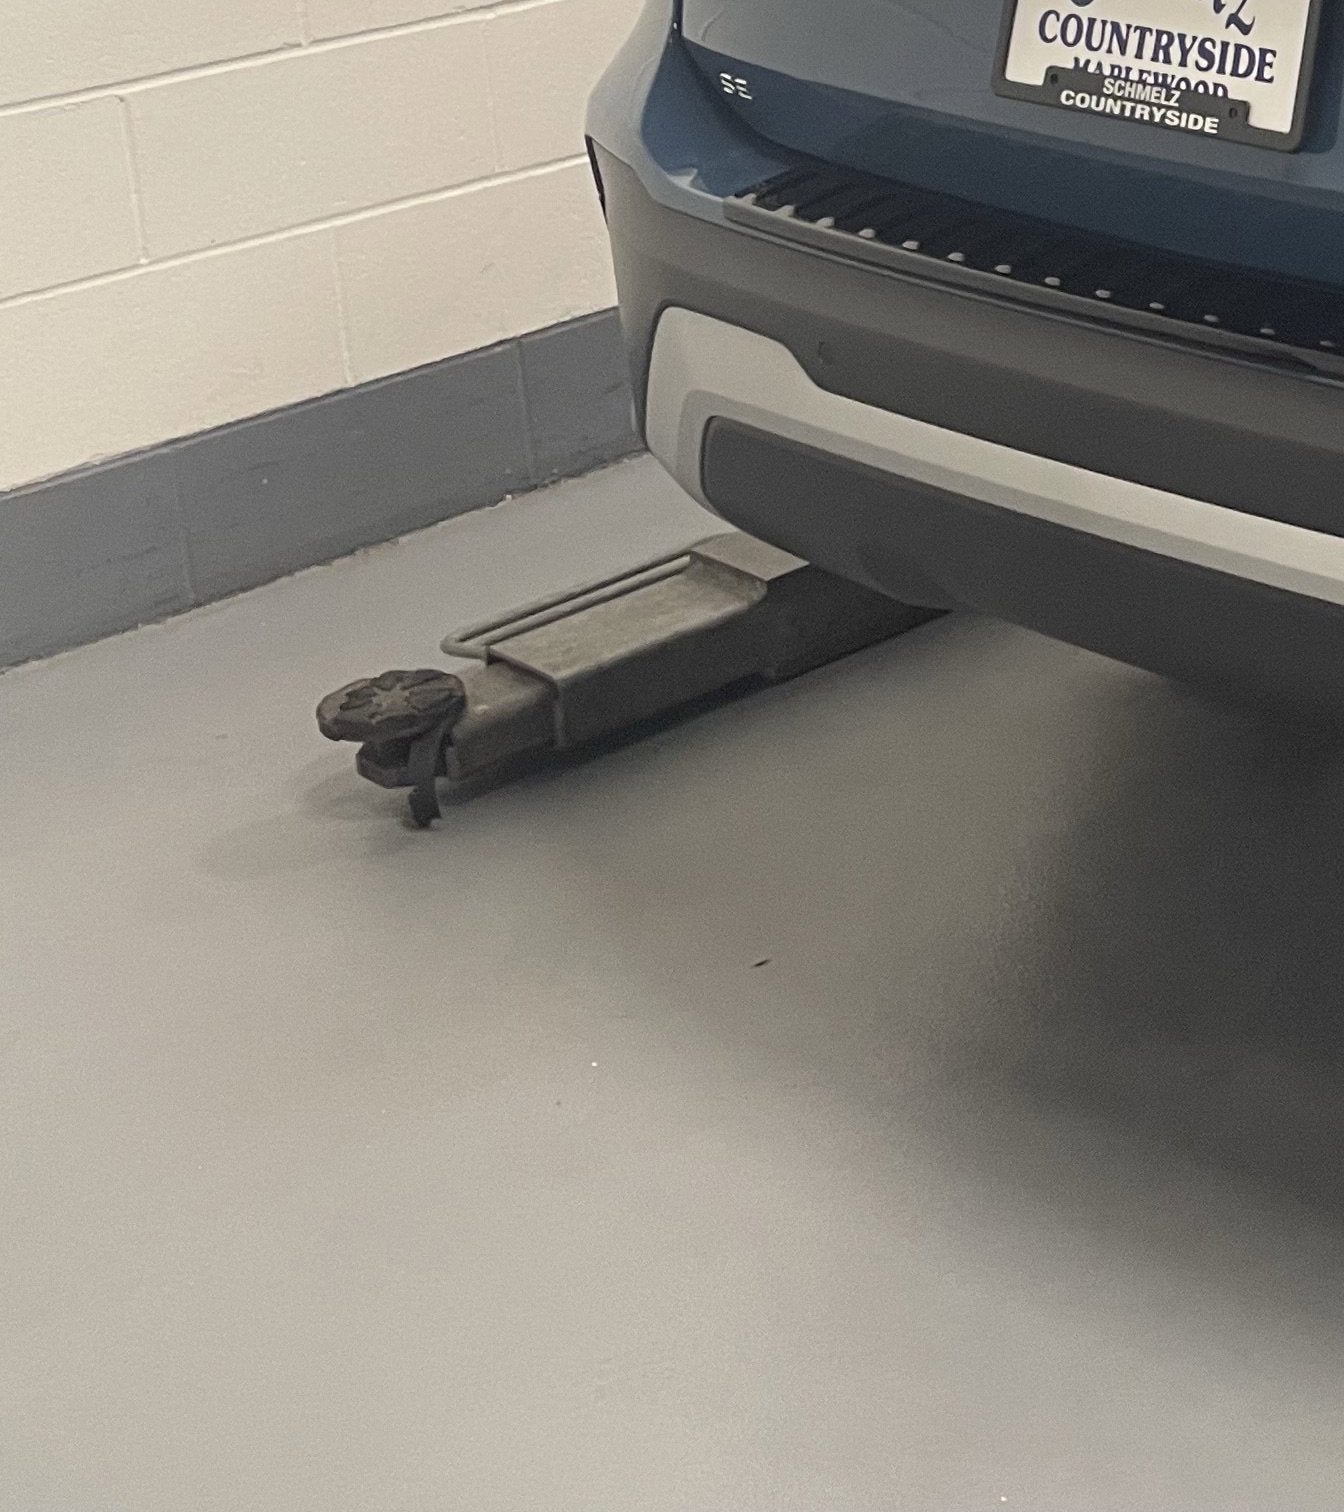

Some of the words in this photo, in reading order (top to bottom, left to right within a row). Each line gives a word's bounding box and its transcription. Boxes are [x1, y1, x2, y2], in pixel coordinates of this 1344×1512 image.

[1039, 9, 1277, 84] COUNTRYSIDE
[719, 72, 752, 100] SE
[1103, 78, 1181, 107] SCHMELZ
[1060, 89, 1220, 134] COUNTRYSIDE
